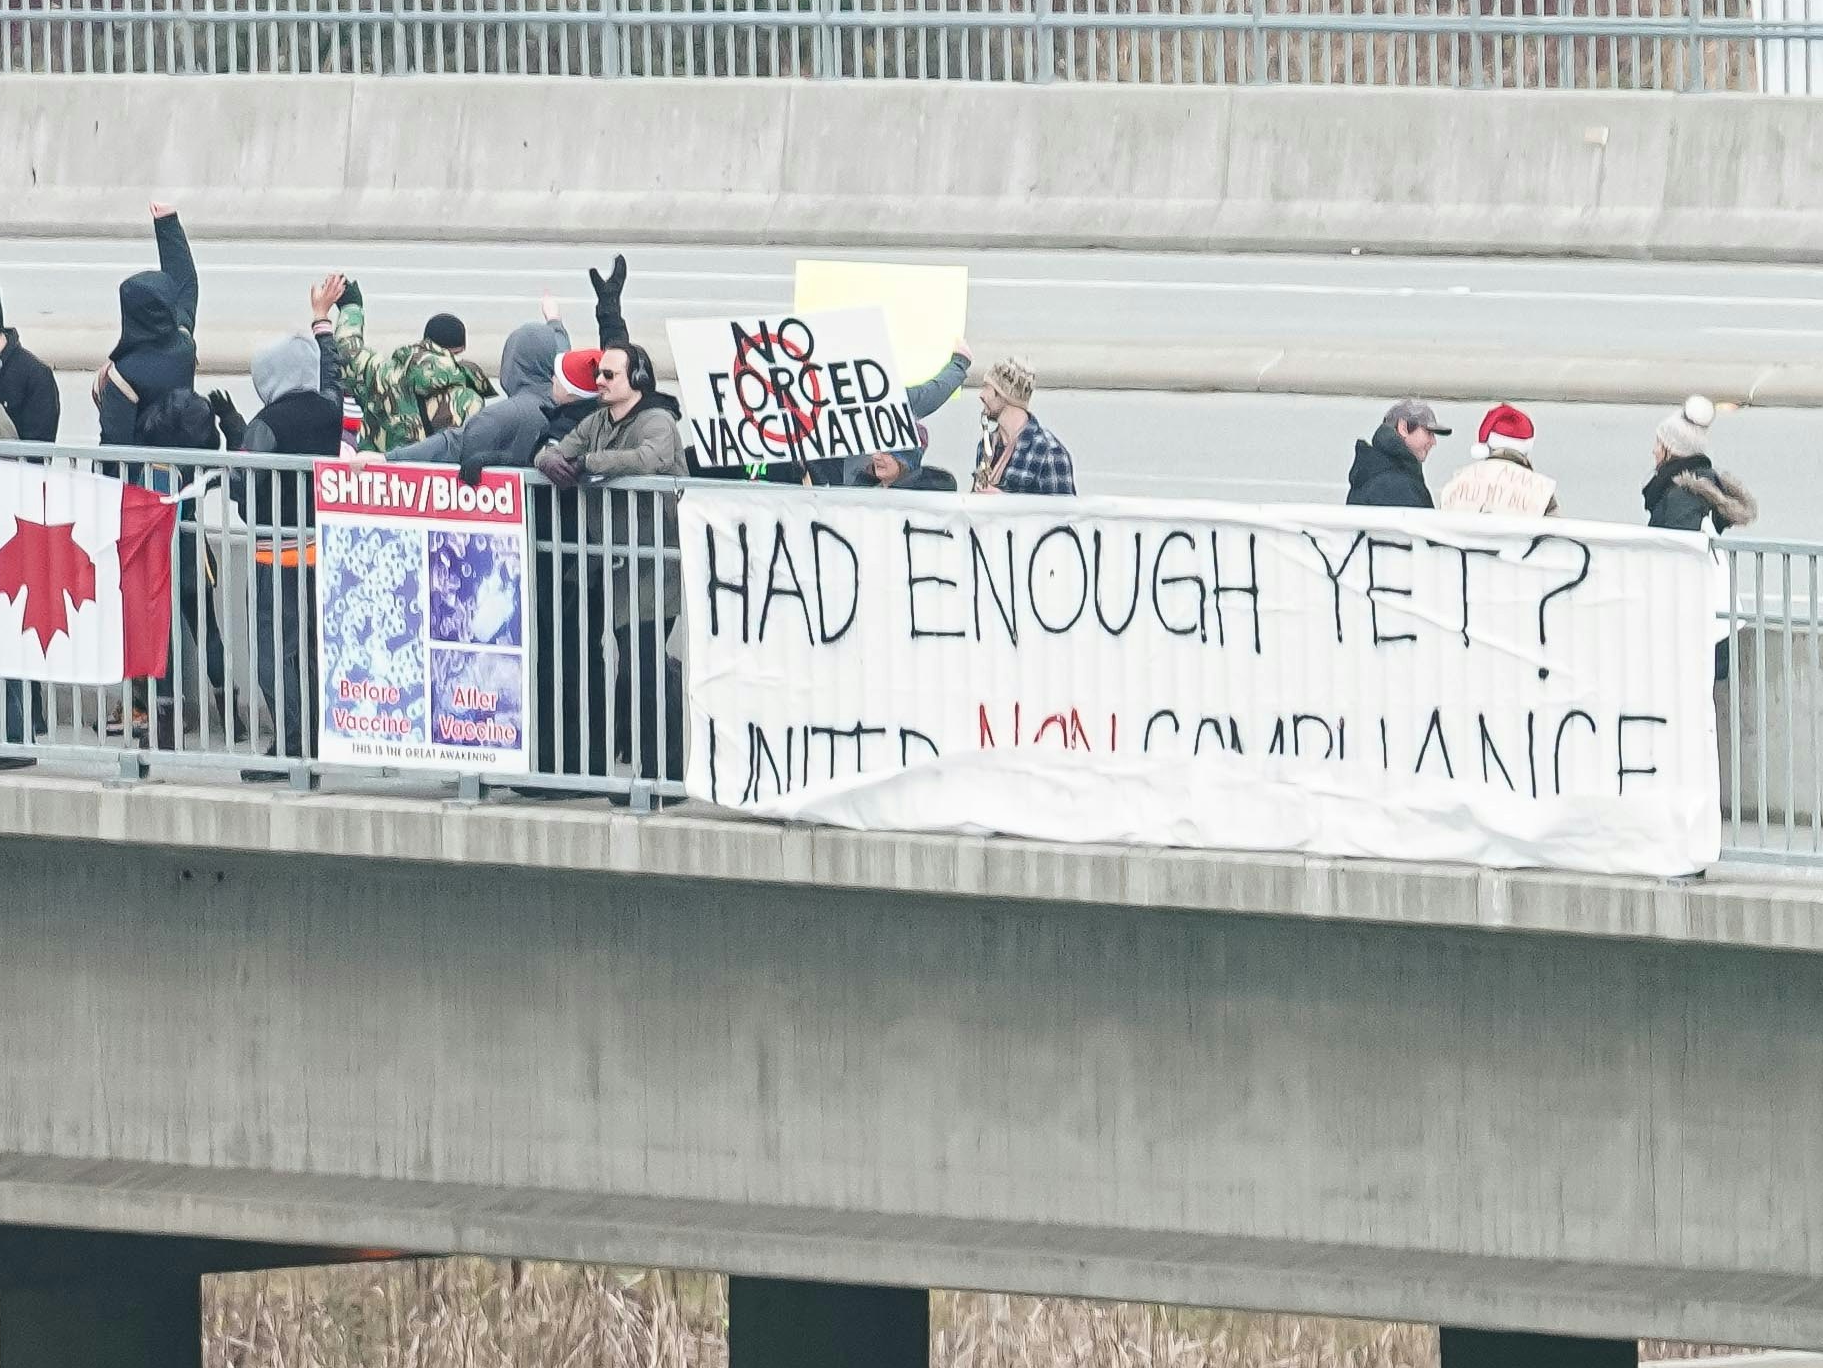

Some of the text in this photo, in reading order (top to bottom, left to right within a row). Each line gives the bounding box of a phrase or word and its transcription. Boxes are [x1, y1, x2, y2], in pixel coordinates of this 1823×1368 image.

[729, 317, 815, 366] NO
[708, 358, 890, 415] FORCED
[691, 402, 923, 468] VACCINATION
[319, 467, 515, 515] SHTF.tv/Blood
[703, 516, 1592, 682] HAD ENOUGH YET?
[339, 678, 401, 704] Before
[453, 685, 498, 712] After
[332, 706, 412, 736] Vaccine
[438, 714, 518, 746] Vaccine
[352, 742, 497, 764] THIS IS THE GREAT AWAKENING
